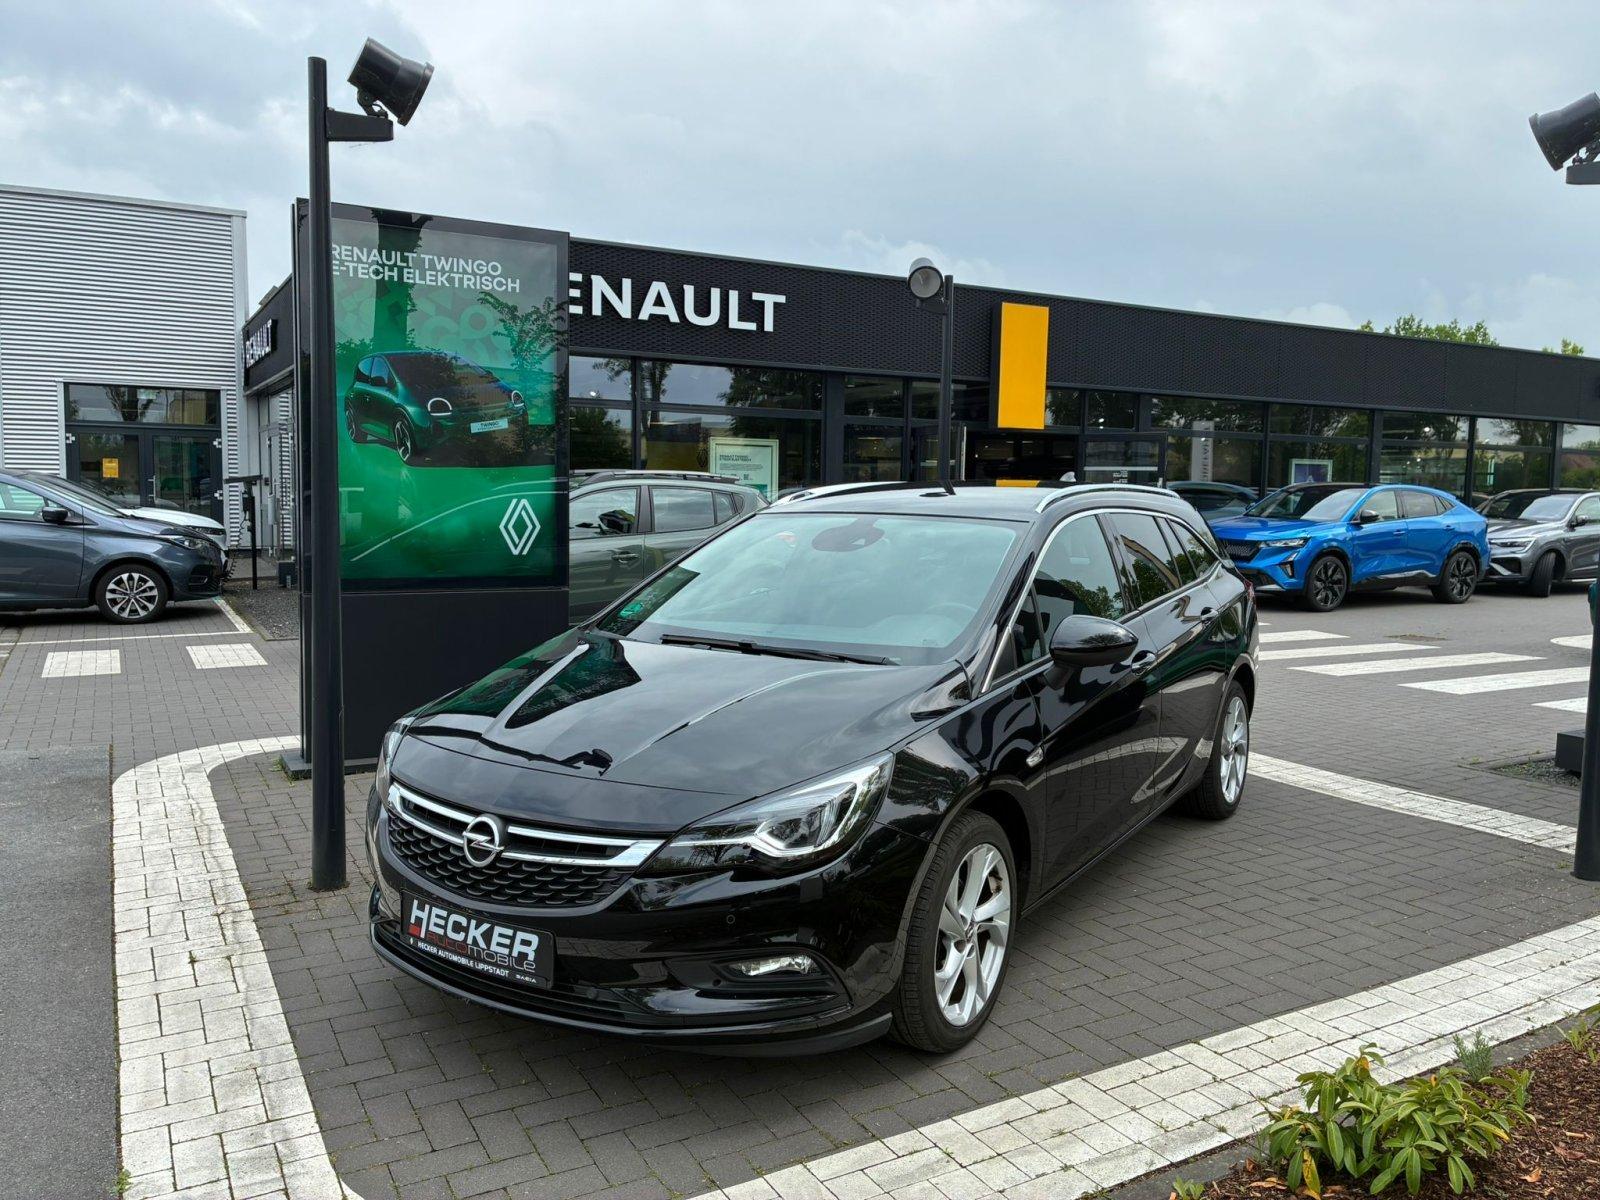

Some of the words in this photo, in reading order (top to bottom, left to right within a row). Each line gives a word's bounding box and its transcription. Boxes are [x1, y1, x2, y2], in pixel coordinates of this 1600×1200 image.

[332, 244, 417, 267] RENAULT
[420, 254, 502, 276] TWINGO
[332, 260, 398, 282] E-TECH
[403, 268, 520, 293] ELEKTRISCH
[410, 899, 539, 961] HECKER
[417, 941, 438, 955] HECKER
[438, 949, 474, 968] AUTOMOBILE
[474, 960, 510, 977] LIPPSTADT
